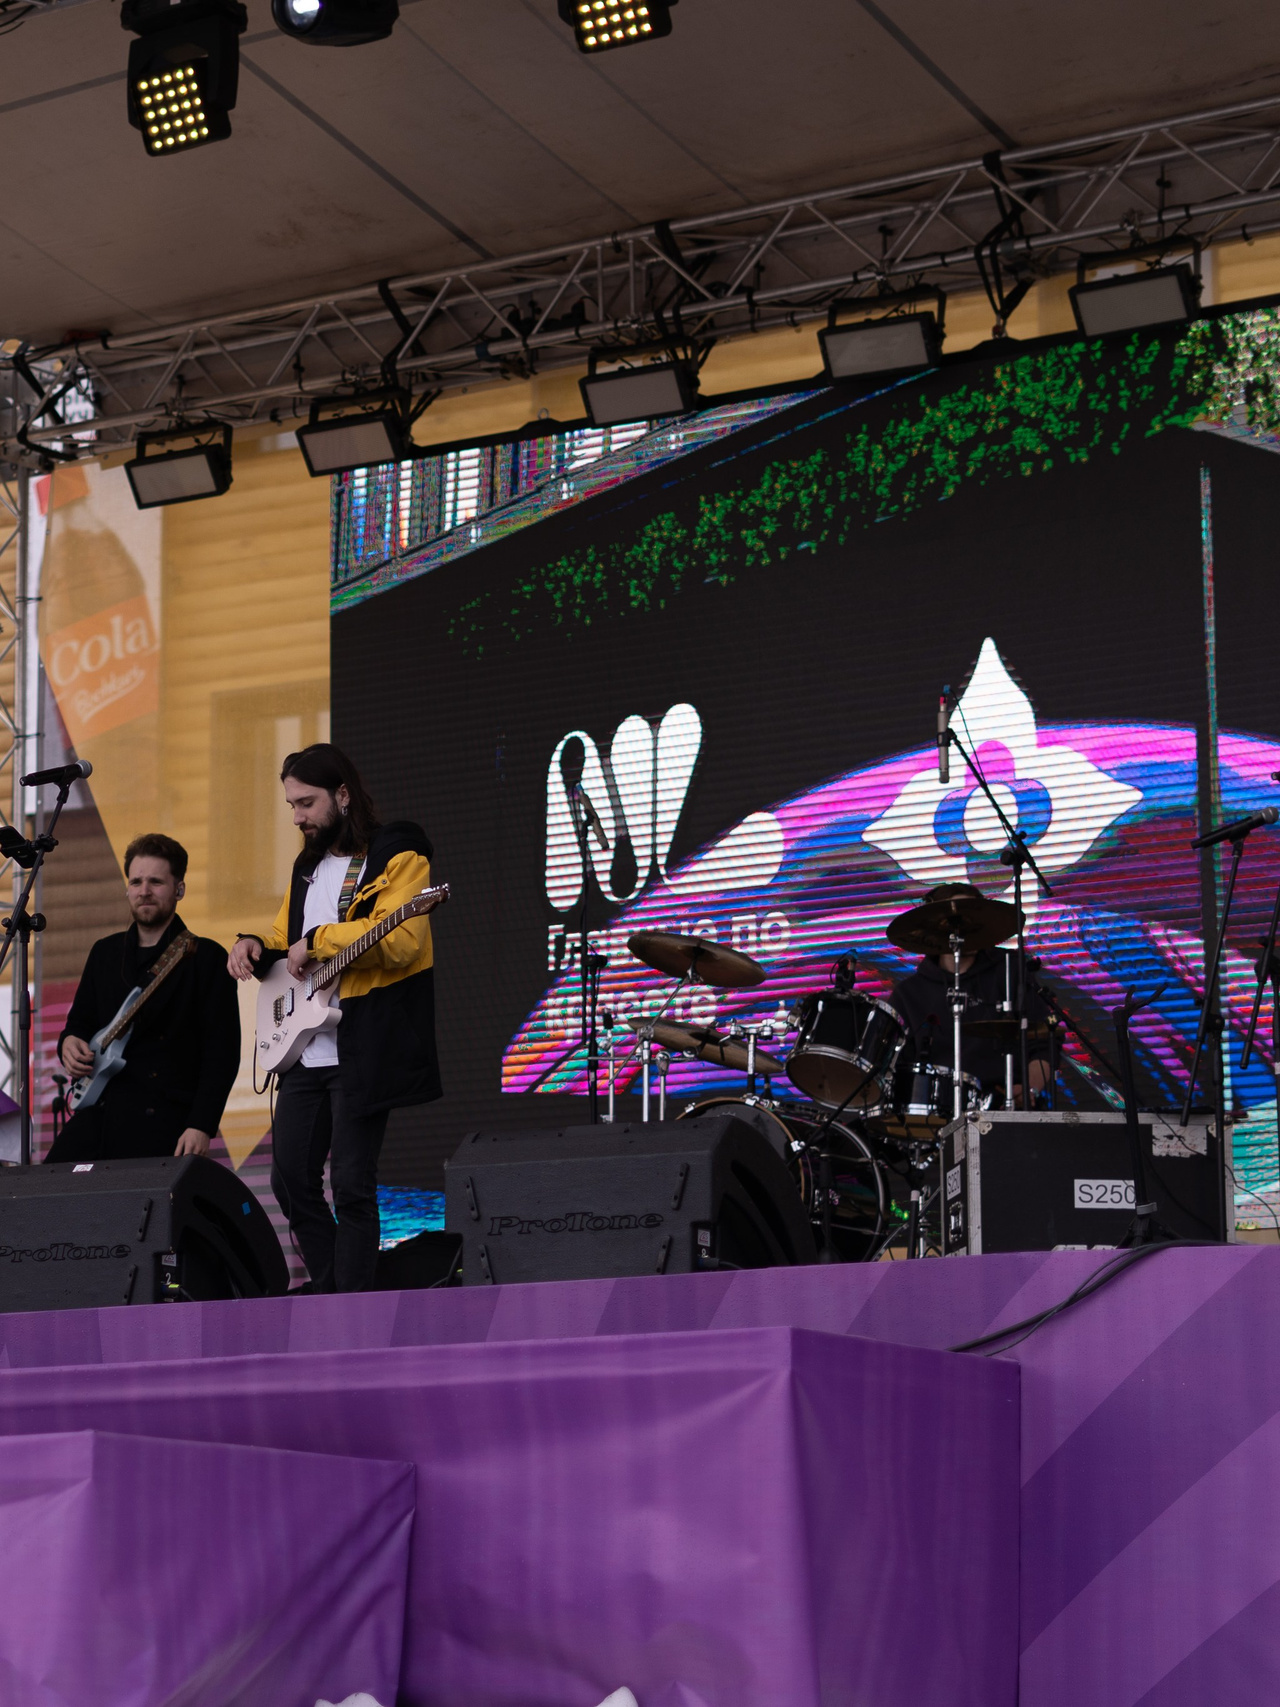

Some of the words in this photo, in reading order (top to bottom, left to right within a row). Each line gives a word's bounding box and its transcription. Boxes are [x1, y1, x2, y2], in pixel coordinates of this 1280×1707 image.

[51, 614, 150, 687] Cola
[1078, 1184, 1137, 1204] S250
[487, 1211, 665, 1236] ProTone
